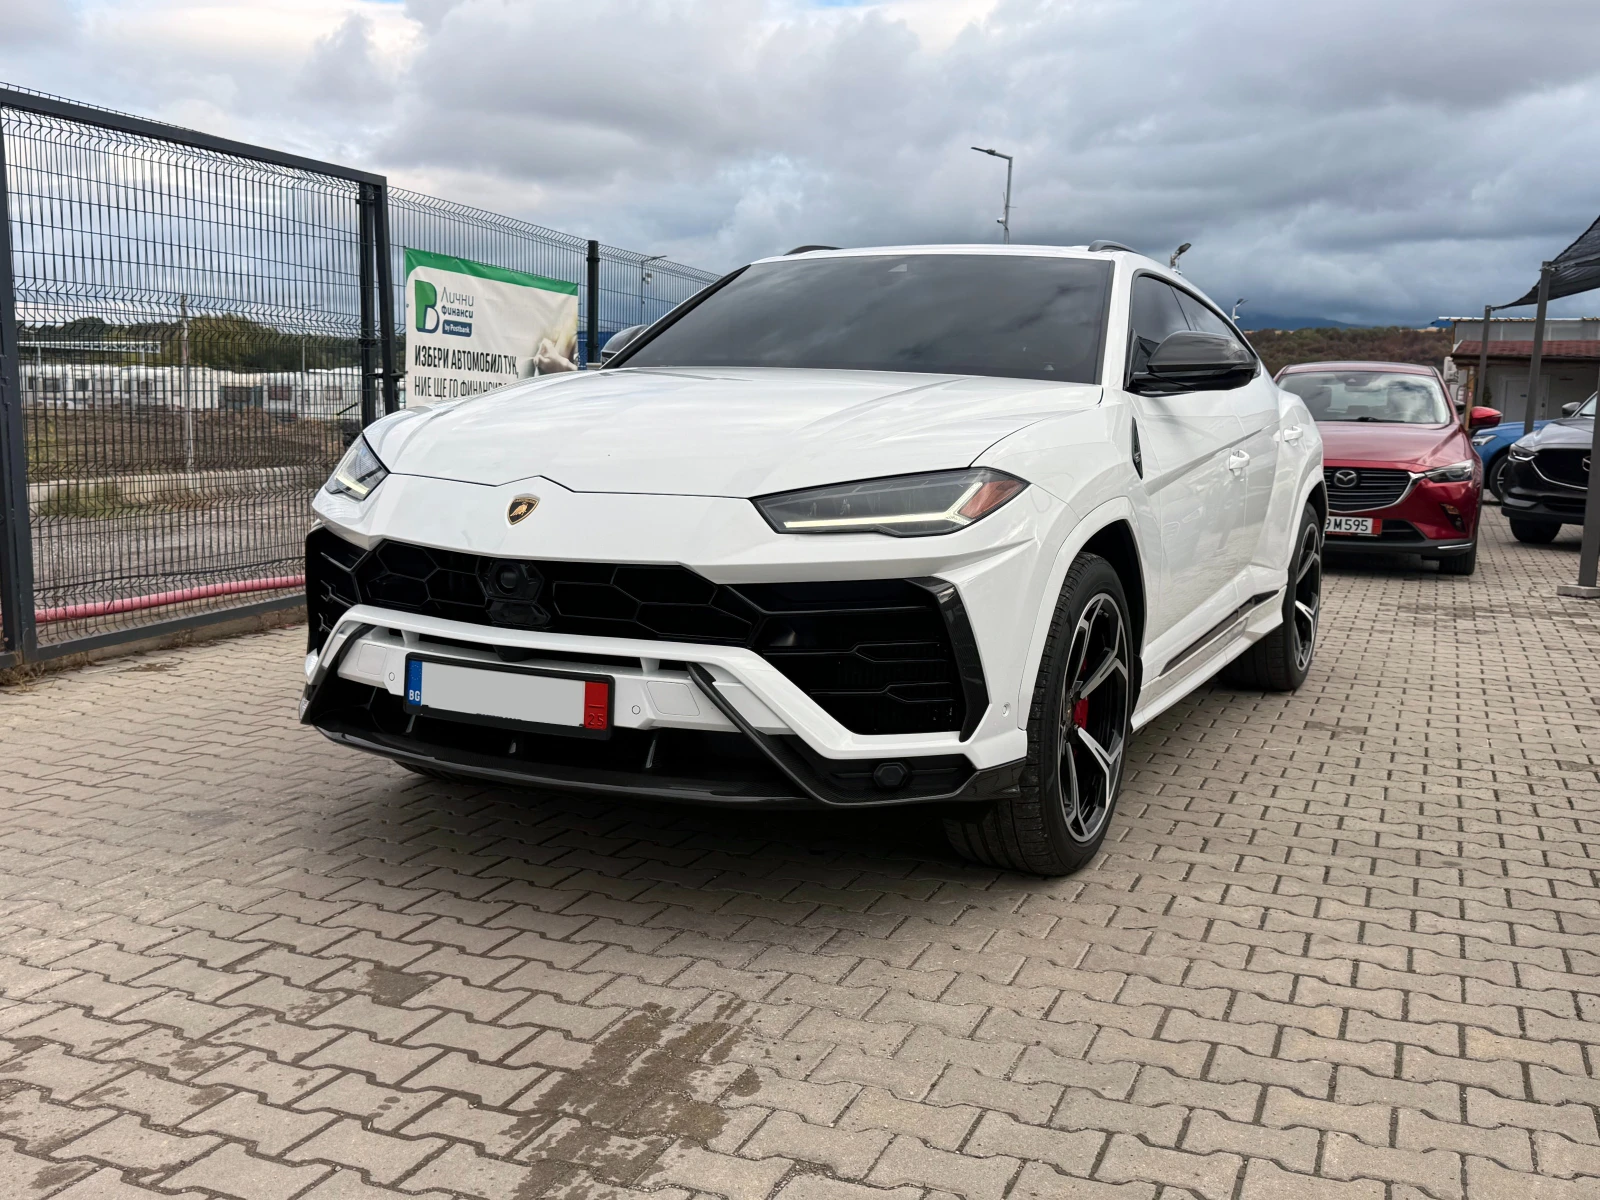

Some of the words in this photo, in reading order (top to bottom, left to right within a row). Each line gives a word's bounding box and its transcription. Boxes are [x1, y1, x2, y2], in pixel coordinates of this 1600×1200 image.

[441, 287, 474, 306] Лични
[444, 323, 450, 332] by
[450, 324, 470, 333] Postbank
[414, 345, 449, 369] ИЗБЕРИ
[451, 349, 502, 373] АВТОМОБИЛ
[503, 355, 519, 378] ТУК,
[415, 376, 431, 396] НИЕ
[434, 377, 446, 400] ЩЕ
[449, 378, 458, 398] ГО
[409, 690, 420, 702] BG
[588, 712, 604, 726] 25
